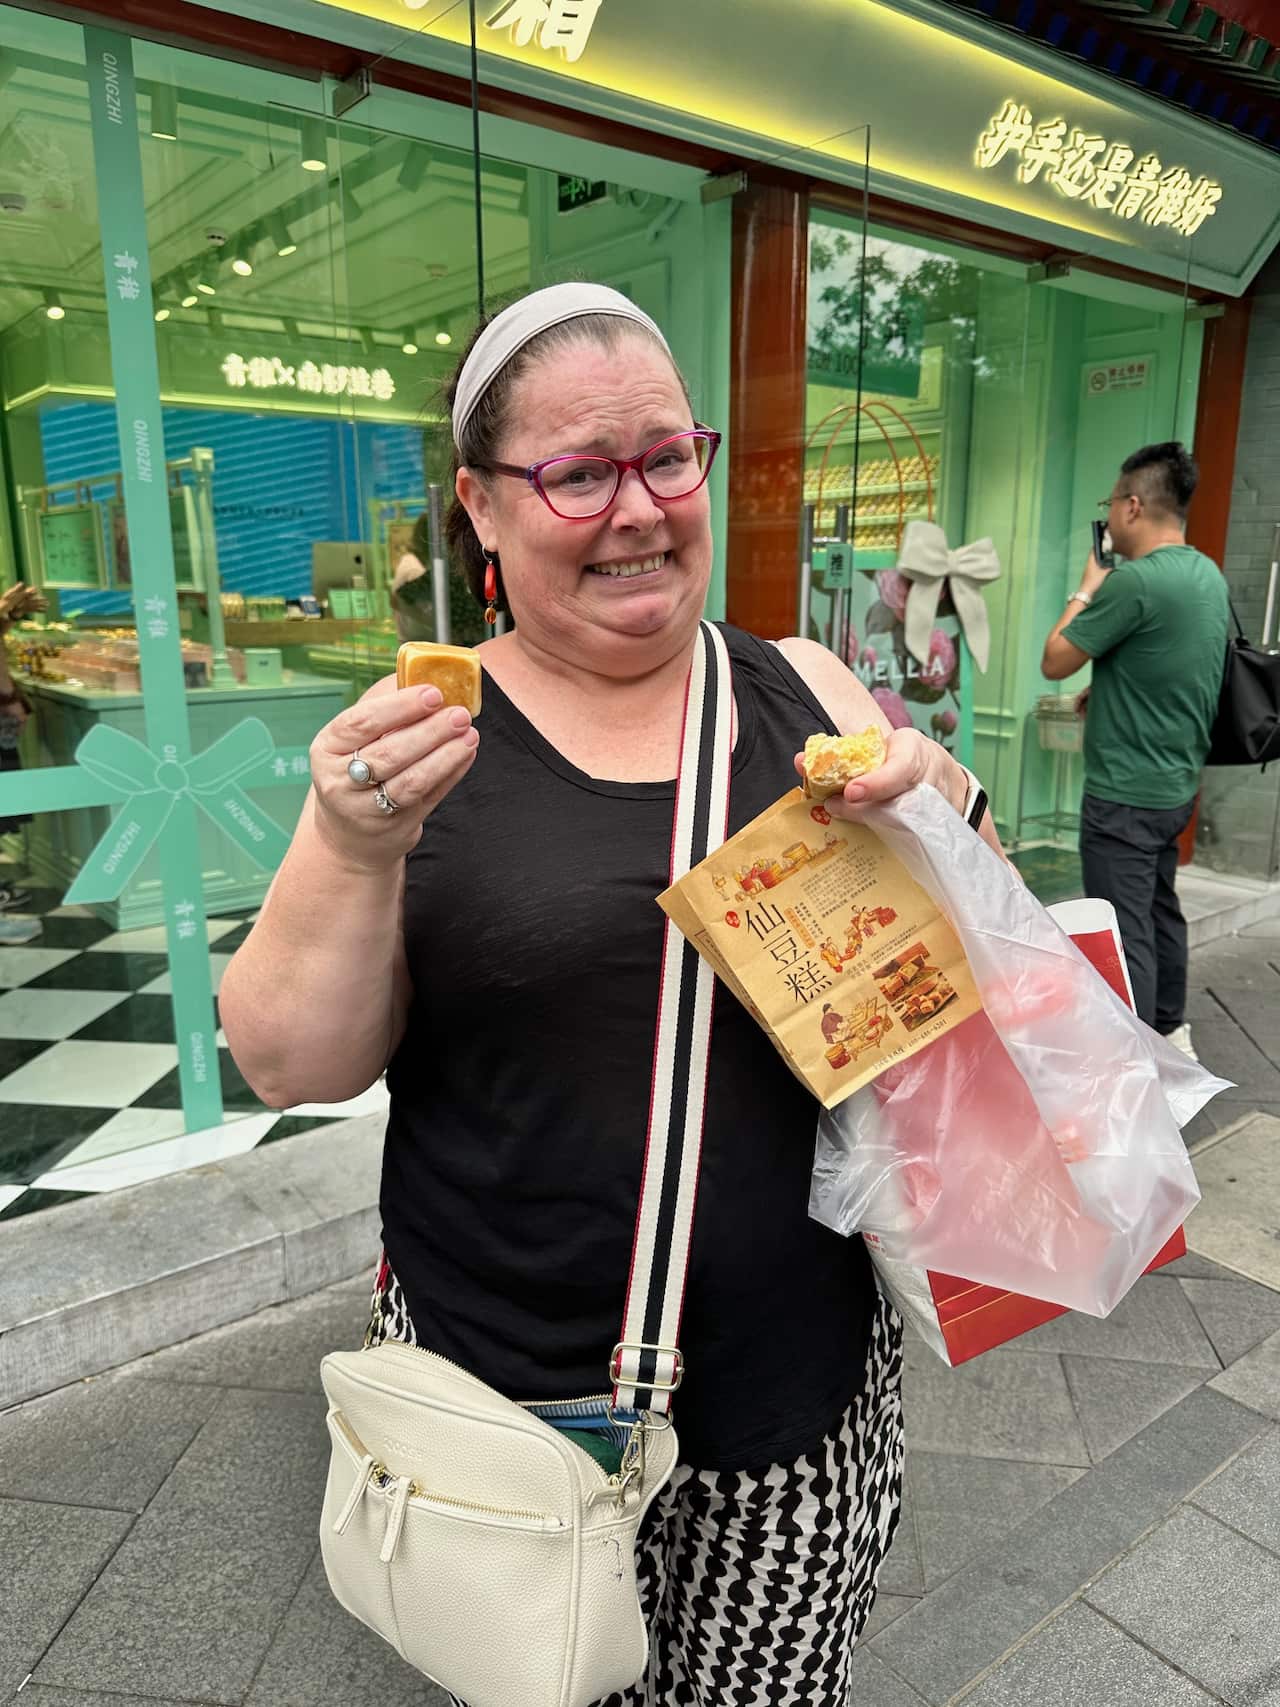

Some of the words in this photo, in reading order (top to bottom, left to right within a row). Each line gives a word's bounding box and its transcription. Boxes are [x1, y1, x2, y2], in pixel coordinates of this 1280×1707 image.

[103, 52, 122, 125] QINGZHI
[134, 419, 153, 483] QINGZHI
[102, 820, 141, 875] QINGZHI
[745, 901, 833, 1004] 仙豆糕
